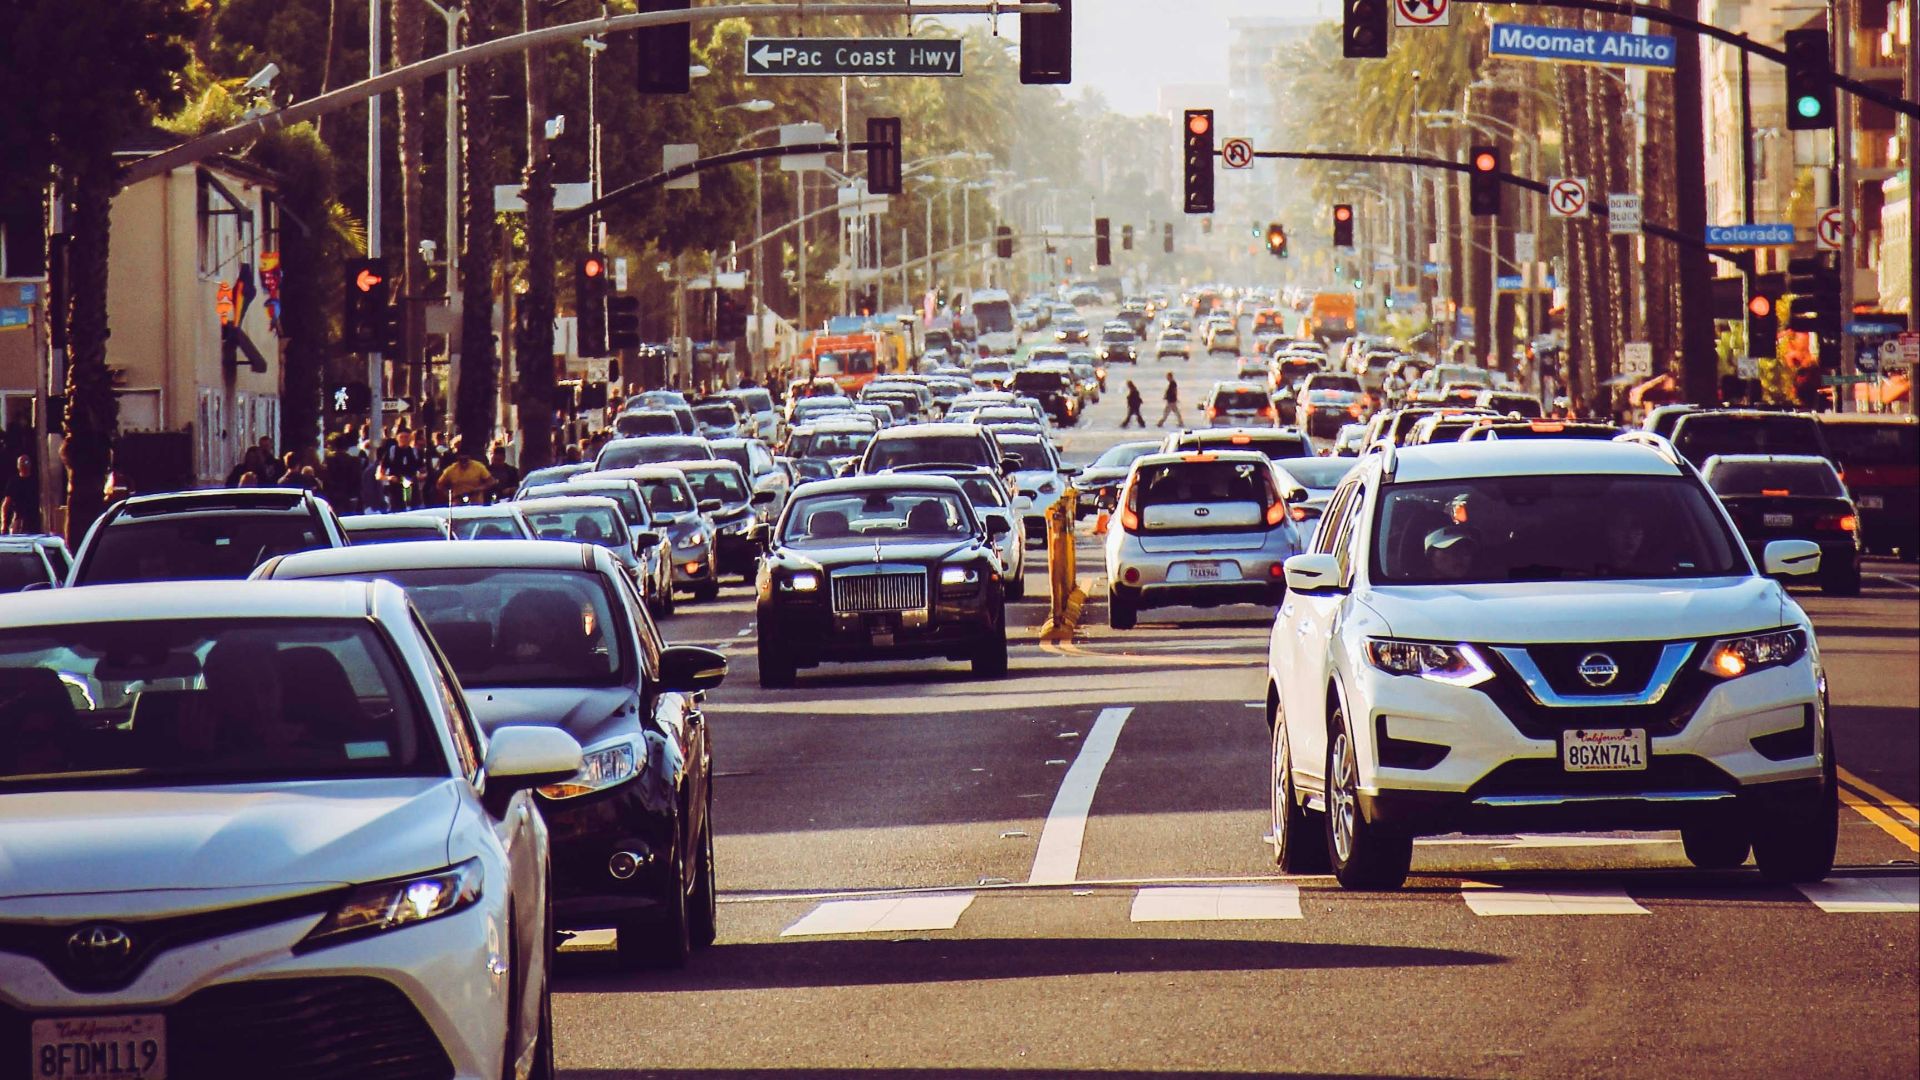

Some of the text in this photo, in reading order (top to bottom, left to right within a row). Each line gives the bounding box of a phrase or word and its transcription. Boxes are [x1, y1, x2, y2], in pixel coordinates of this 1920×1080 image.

[1499, 28, 1670, 60] Moomat Ahiko
[782, 47, 956, 70] Pac Coast Hwy
[1611, 199, 1638, 208] DO NOT
[1710, 226, 1788, 241] Colorado
[1580, 664, 1616, 674] NISSAN
[1581, 732, 1627, 744] California
[1569, 744, 1642, 767] 8GXN741
[41, 1039, 158, 1077] 8FDM119
